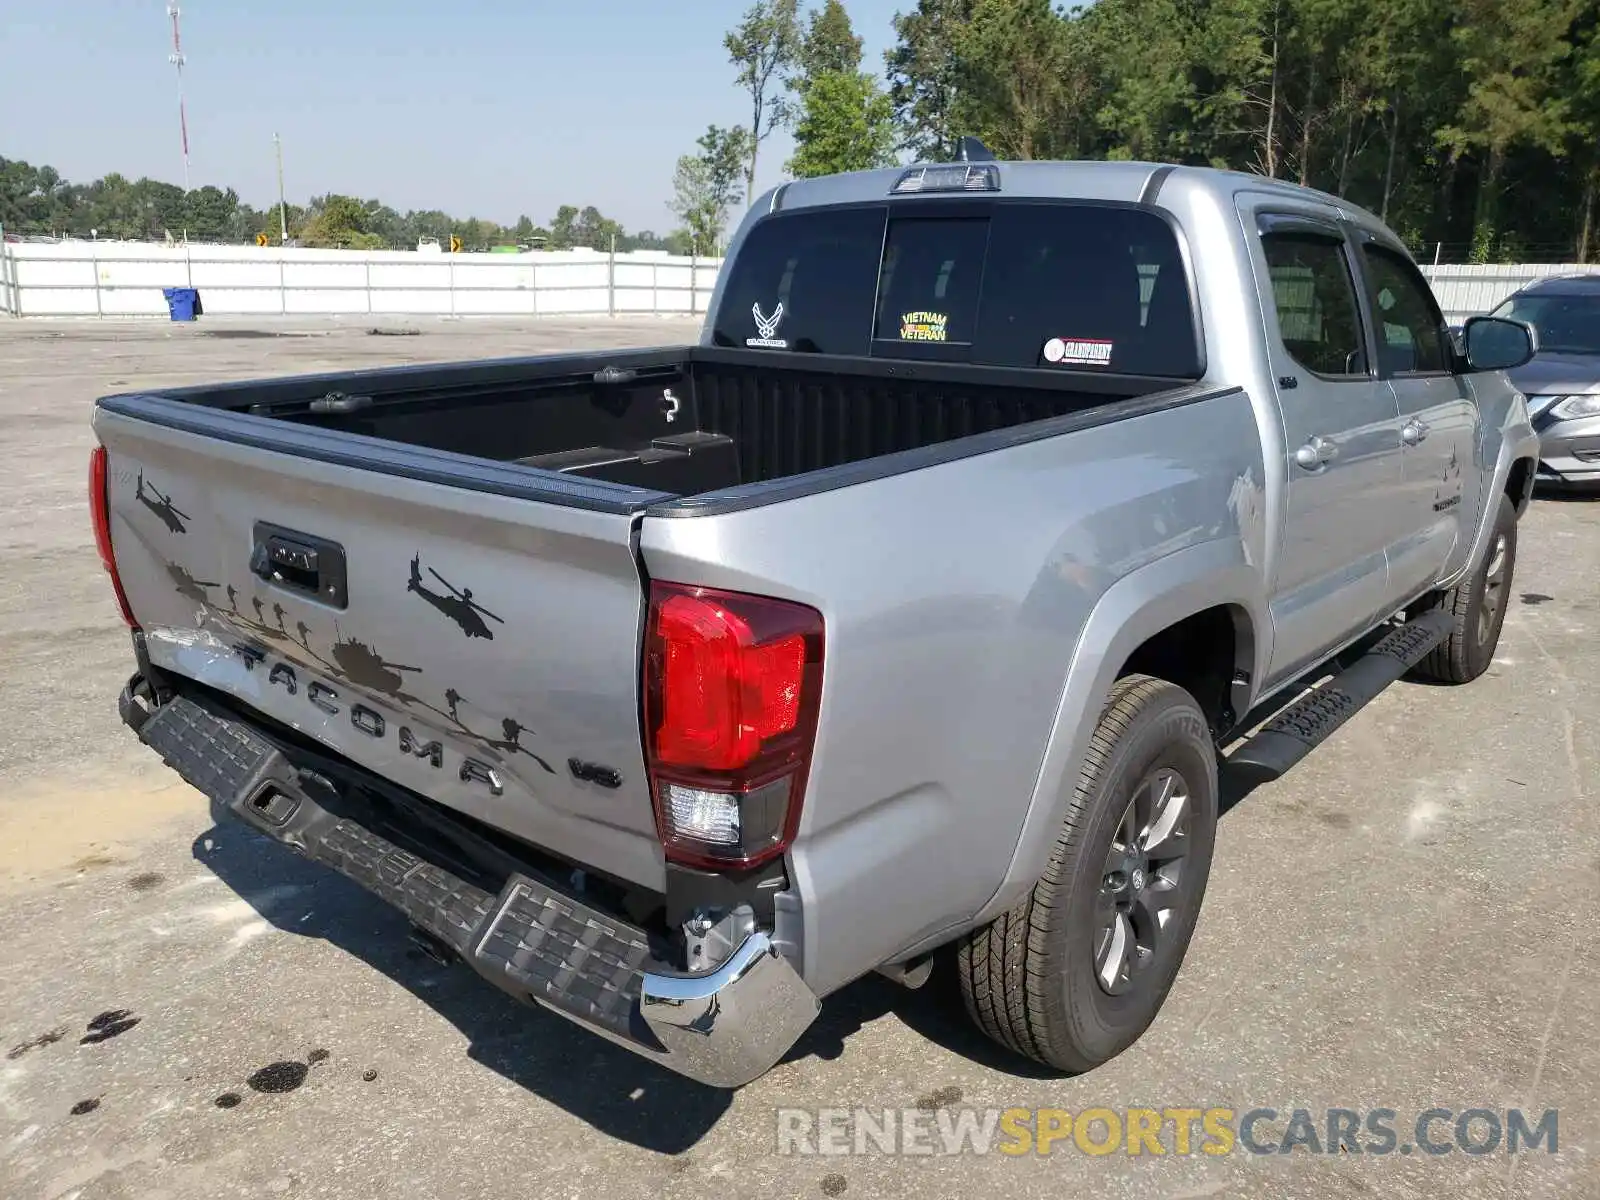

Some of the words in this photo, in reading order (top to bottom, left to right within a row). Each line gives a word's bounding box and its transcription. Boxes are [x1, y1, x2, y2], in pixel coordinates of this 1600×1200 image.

[902, 311, 947, 327] VIETNAM
[900, 328, 946, 341] VETERAN
[232, 641, 504, 796] TACOMA
